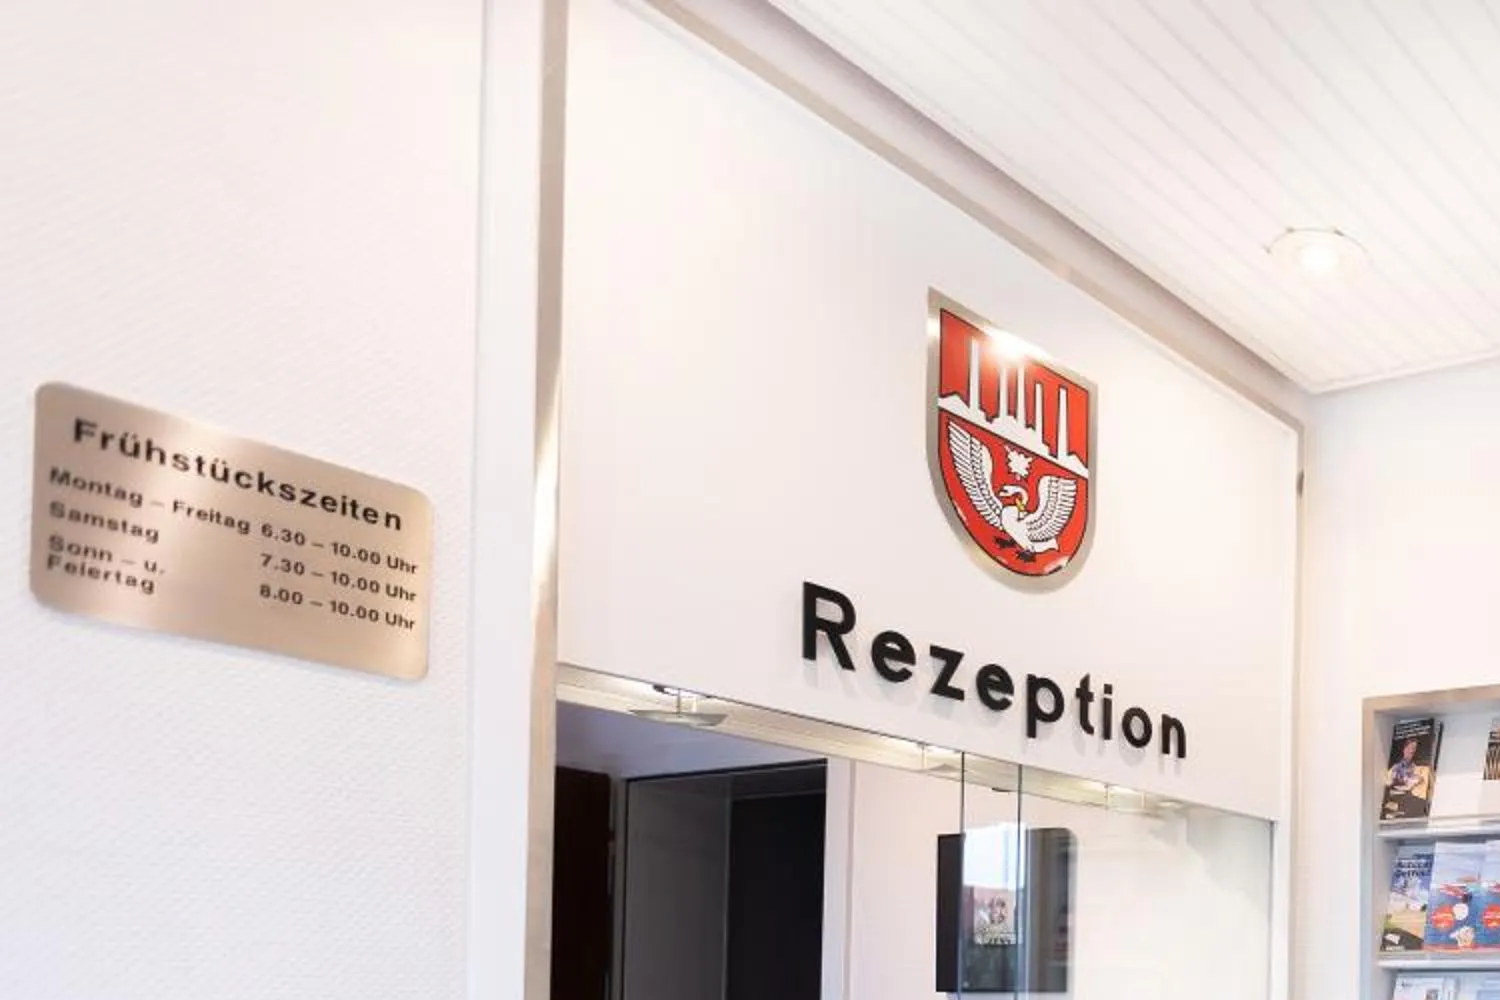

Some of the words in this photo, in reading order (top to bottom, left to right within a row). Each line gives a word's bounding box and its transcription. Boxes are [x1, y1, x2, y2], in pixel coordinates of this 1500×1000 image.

[49, 466, 144, 508] Montag
[172, 499, 251, 535] Freitag
[261, 523, 306, 546] 6.30
[331, 541, 381, 566] 10.00
[386, 554, 419, 574] Uhr
[73, 416, 402, 531] Frühstückszeiten
[46, 553, 155, 596] Feiertag
[49, 500, 160, 544] Samstag
[260, 553, 306, 576] 7.30
[331, 570, 380, 594] 10.00
[385, 583, 418, 602] Uhr
[49, 534, 113, 563] Sonn
[143, 559, 166, 575] u.
[259, 584, 304, 606] 8.00
[329, 600, 379, 623] 10.00
[384, 611, 416, 631] Uhr
[802, 581, 1187, 759] Rezeption
